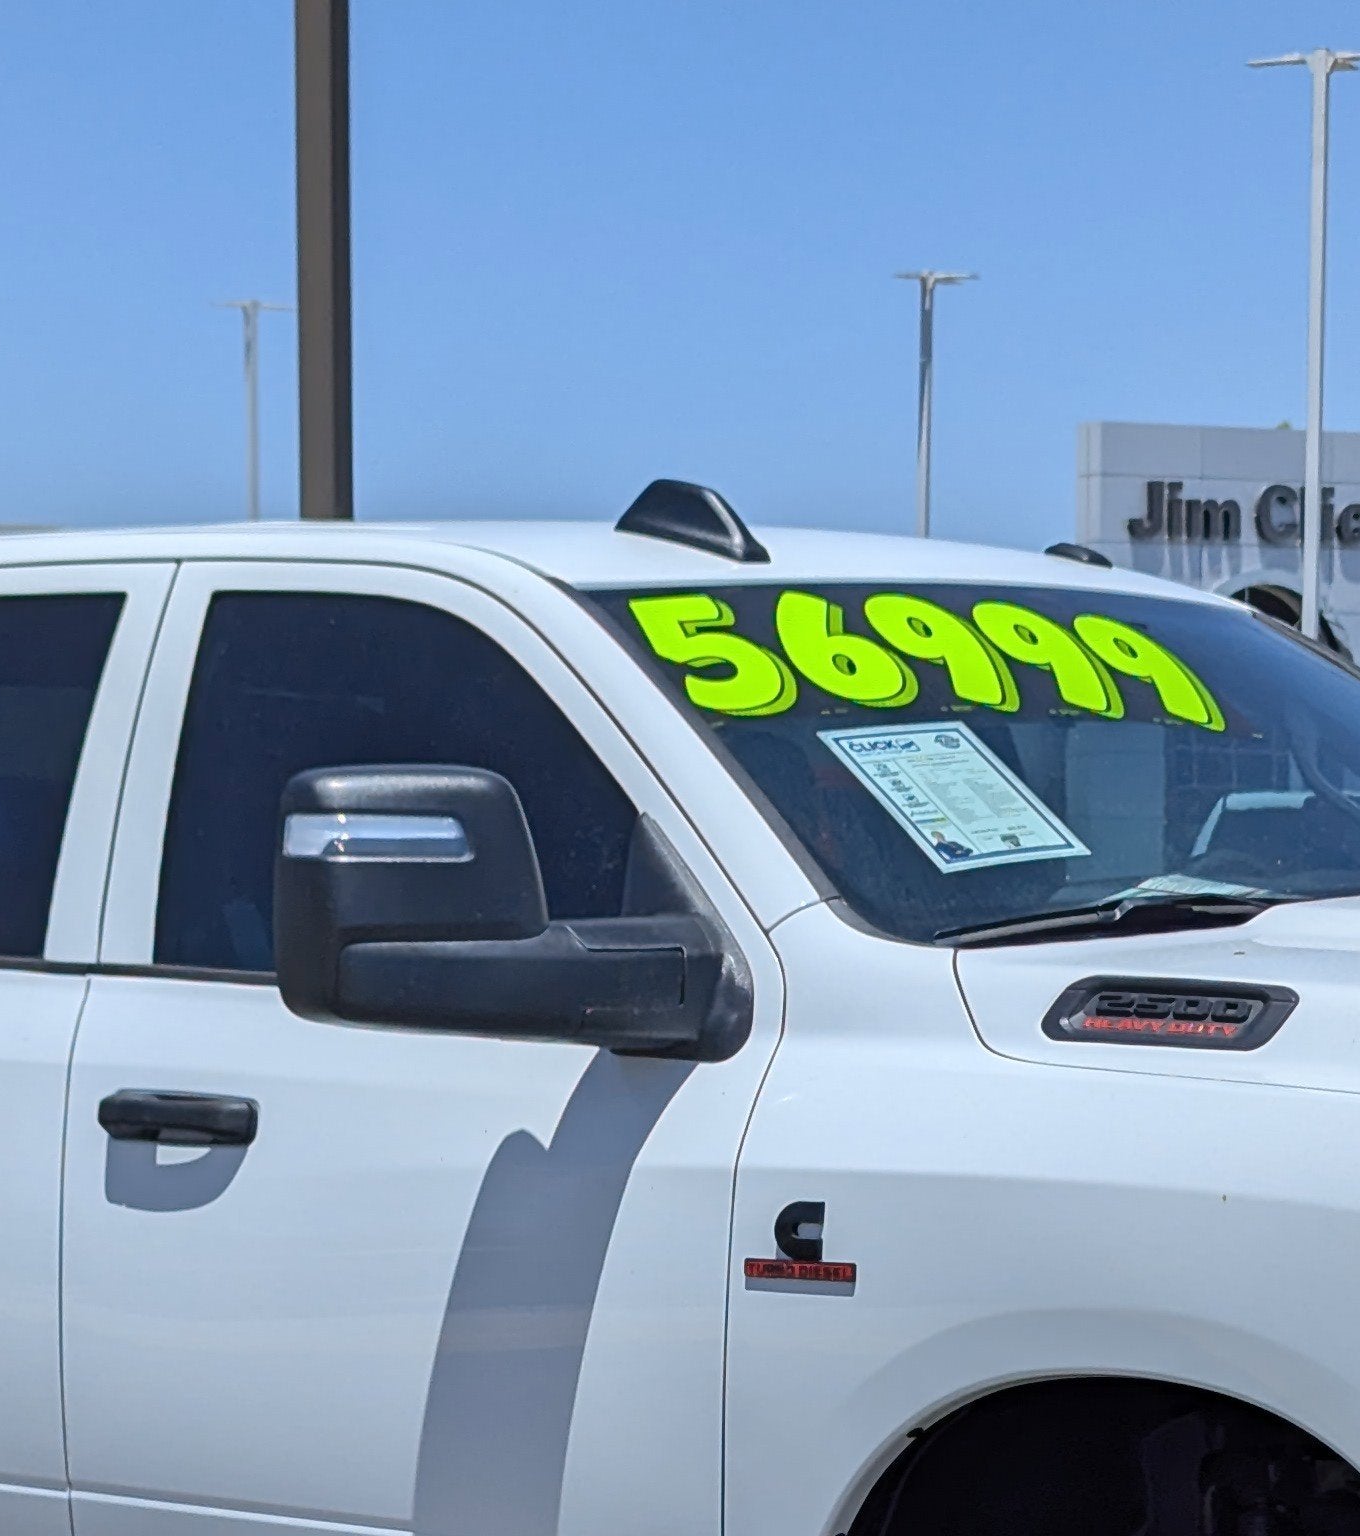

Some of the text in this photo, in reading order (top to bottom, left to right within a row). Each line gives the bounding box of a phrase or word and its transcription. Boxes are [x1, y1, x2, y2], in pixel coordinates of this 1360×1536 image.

[1127, 481, 1240, 541] Jim
[629, 590, 1227, 732] 56999
[1096, 991, 1253, 1024] 2500
